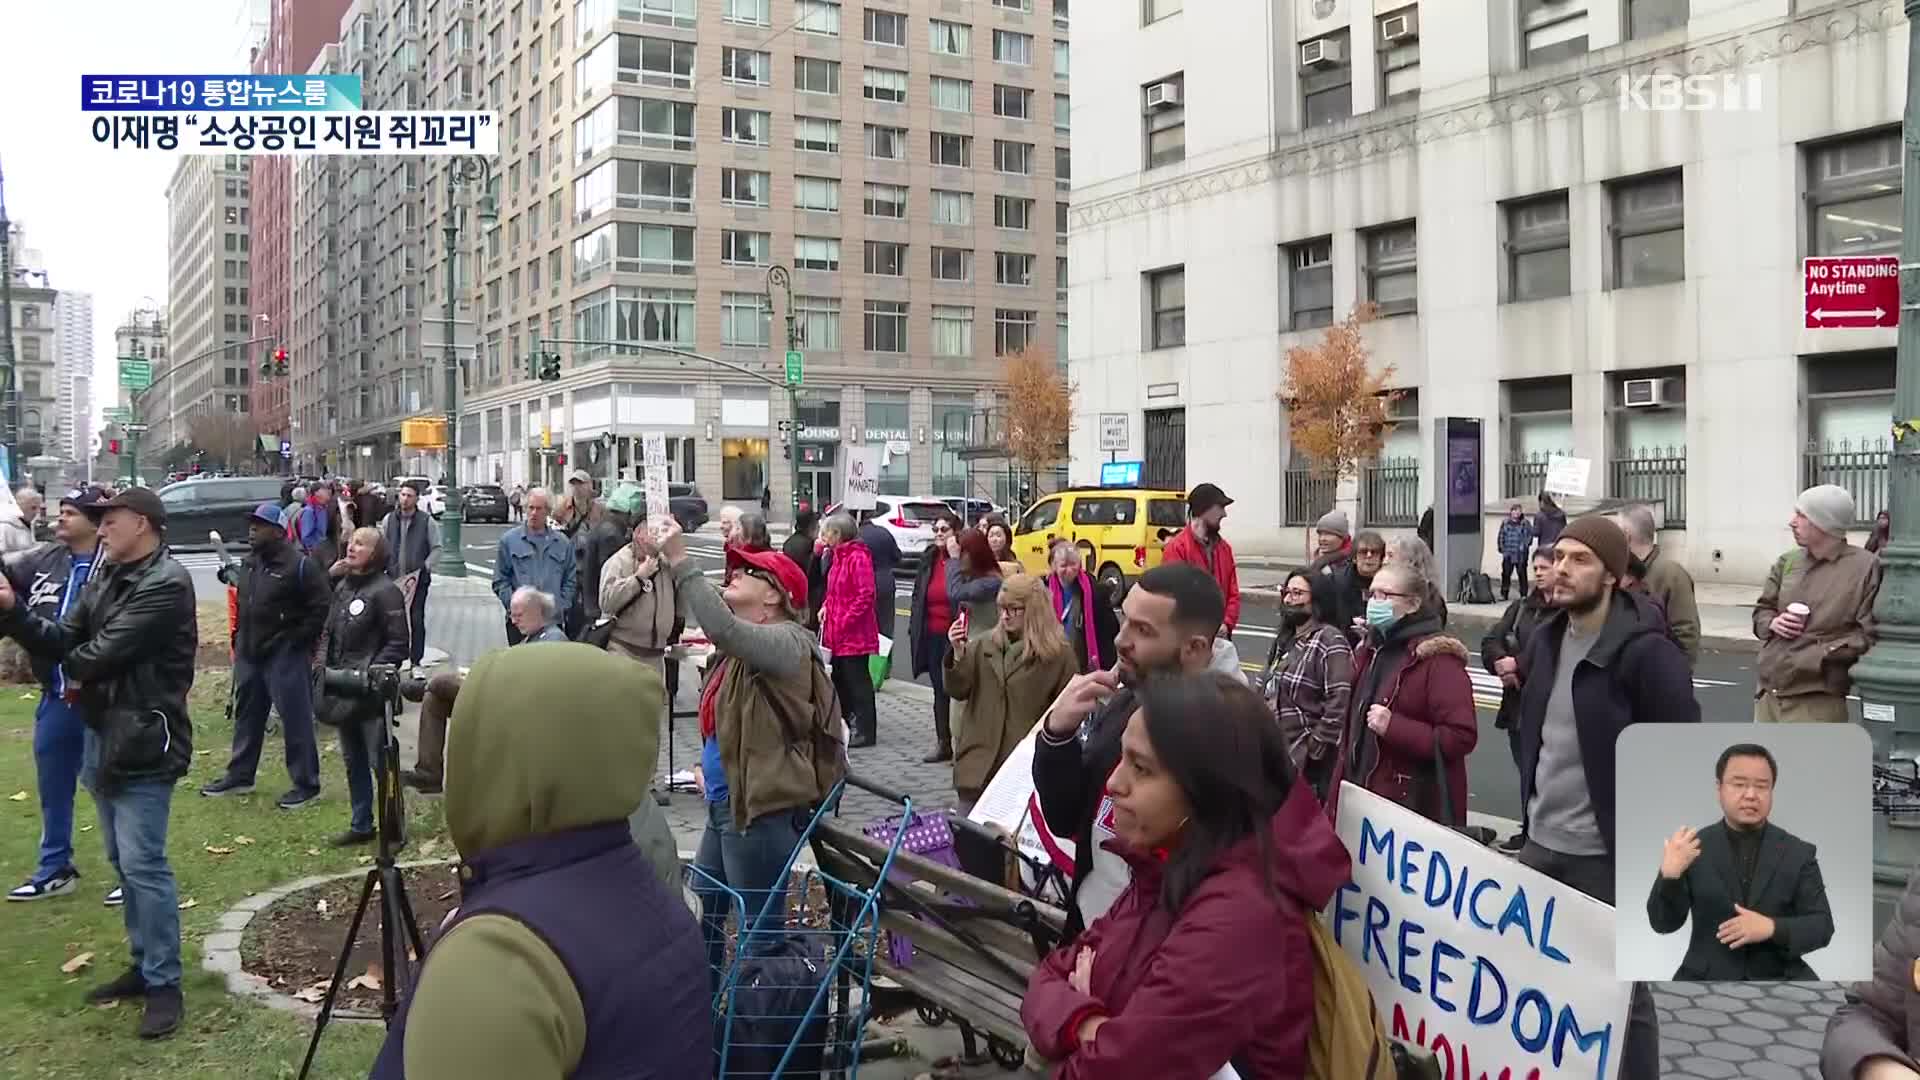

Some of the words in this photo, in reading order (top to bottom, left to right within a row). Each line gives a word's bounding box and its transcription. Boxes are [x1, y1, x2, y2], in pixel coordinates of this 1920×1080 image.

[1810, 265, 1829, 279] NO
[1831, 264, 1898, 279] STANDING
[1810, 281, 1867, 298] Anytime
[865, 429, 909, 440] DENTAL
[851, 459, 864, 476] NO
[1359, 817, 1571, 964] MEDICAL
[1334, 881, 1613, 1080] FREEDOM
